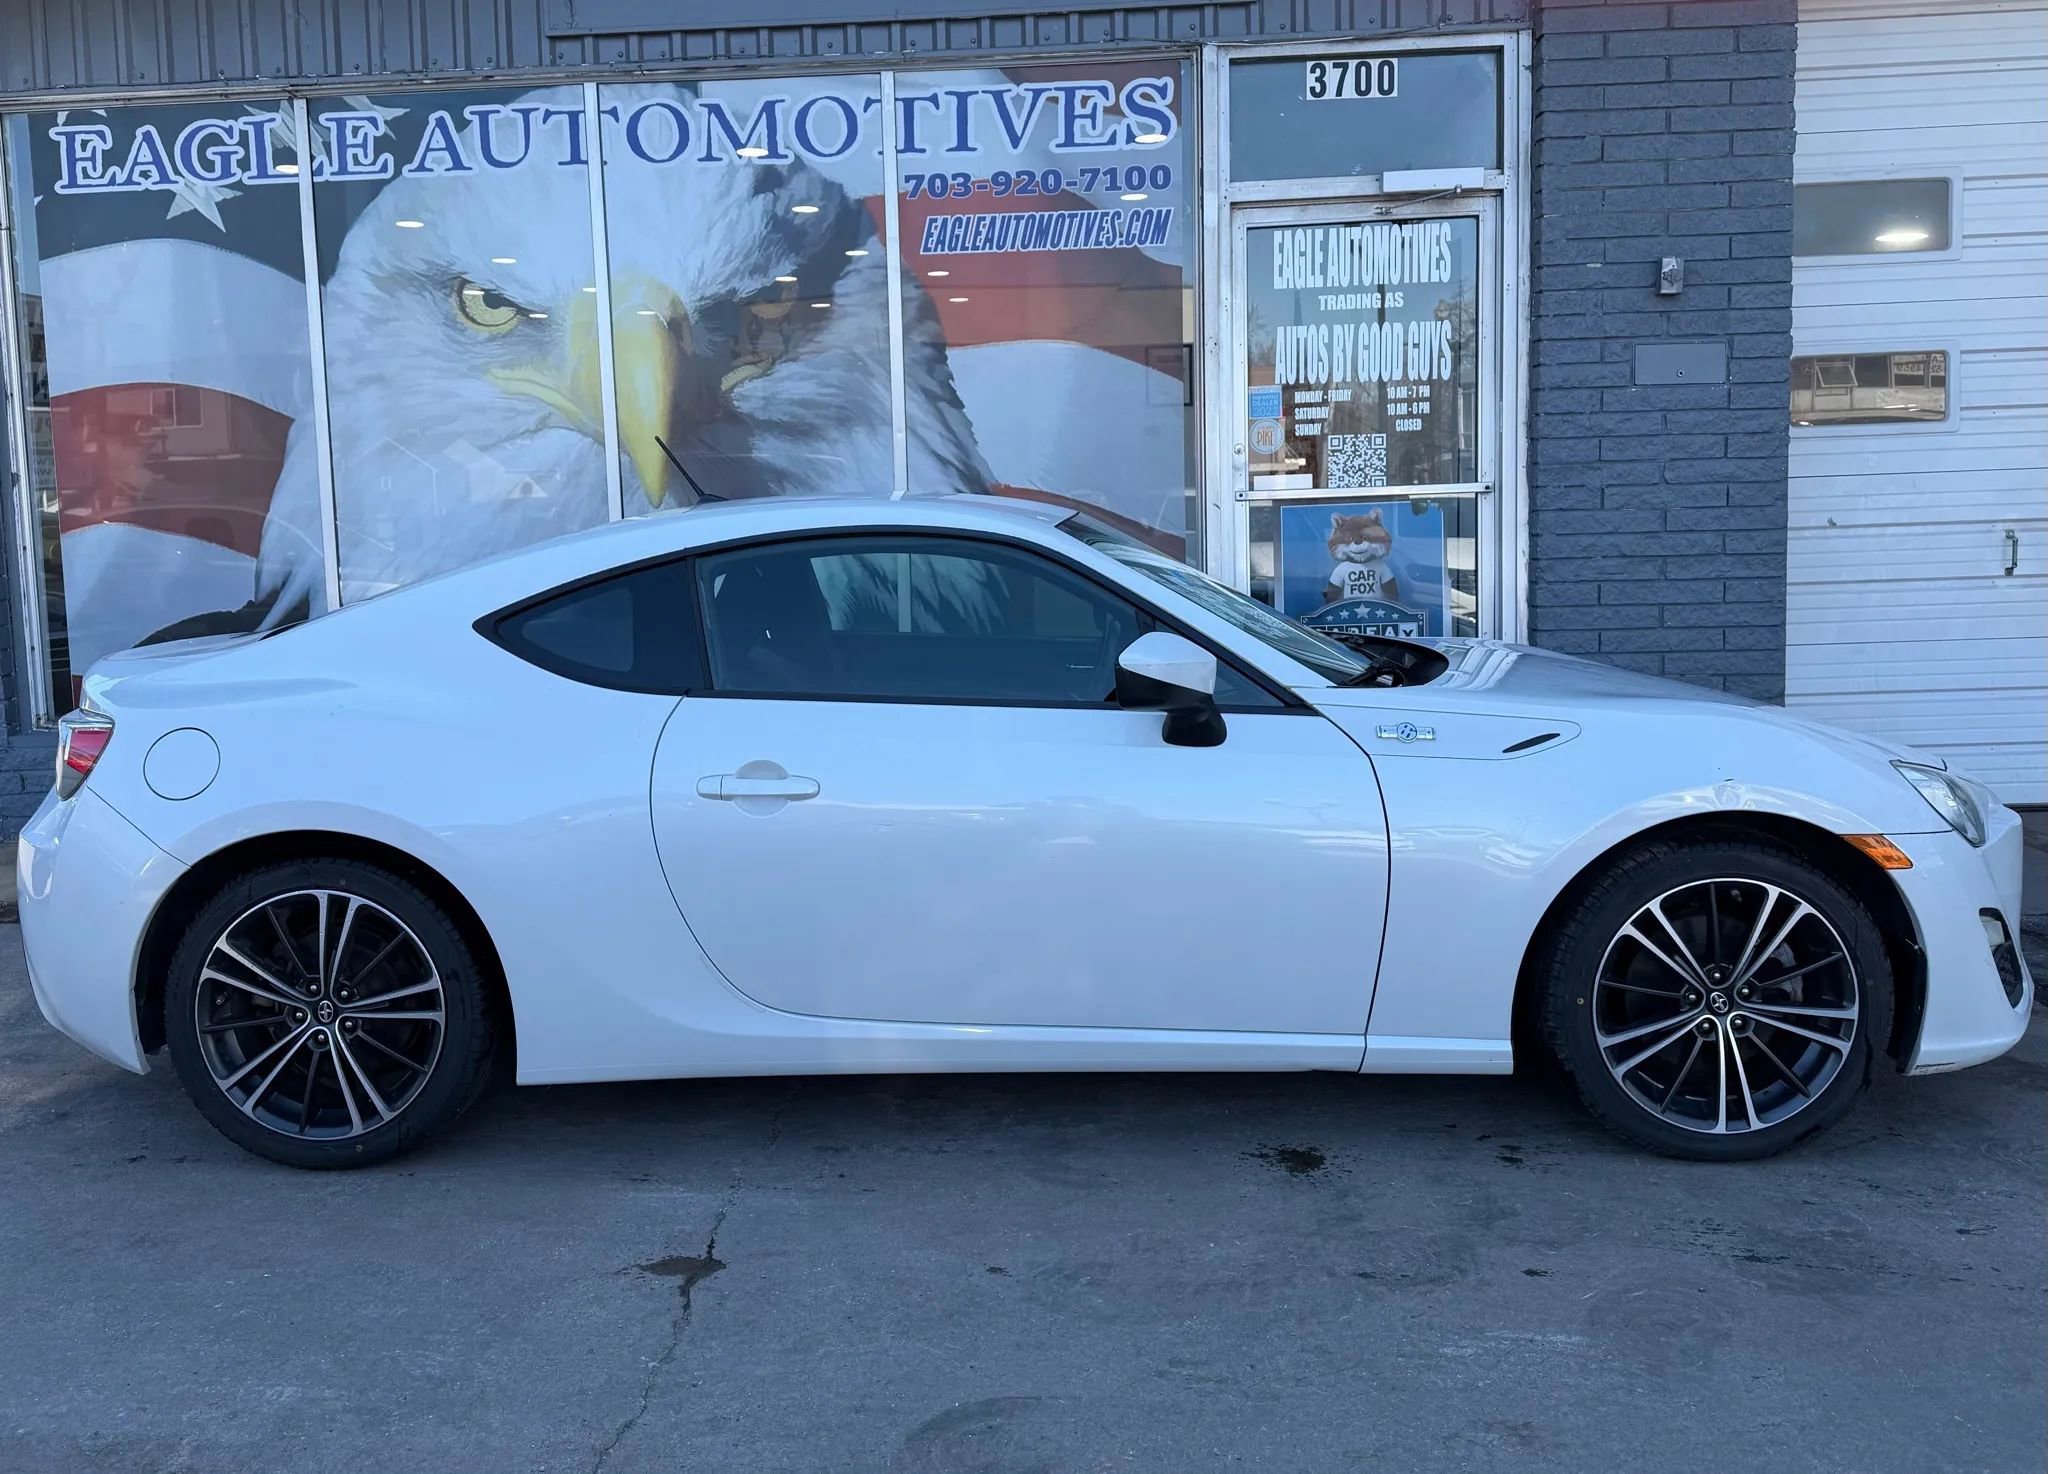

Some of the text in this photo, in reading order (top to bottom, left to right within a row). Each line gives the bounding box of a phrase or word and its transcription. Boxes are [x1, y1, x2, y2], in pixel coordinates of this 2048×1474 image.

[1309, 59, 1395, 98] 3700
[54, 78, 1175, 192] EAGLE AUTOMOTIVES
[904, 165, 1173, 200] 703-920-7100
[920, 208, 1175, 255] EAGLEAUTOMOTIVES.COM
[1273, 222, 1452, 290] EAGLE AUTOMOTIVES
[1318, 291, 1404, 311] TRADING AS
[1275, 319, 1452, 385] AUTOS BY GOOD GUYS
[1294, 390, 1323, 404] MONDAY
[1328, 389, 1352, 402] FRIDAY
[1387, 386, 1395, 399] 10
[1396, 386, 1408, 399] AM
[1412, 385, 1417, 398] 7
[1419, 385, 1430, 398] PM
[1294, 406, 1329, 420] SATURDAY
[1387, 403, 1395, 416] 10
[1396, 402, 1408, 415] AM
[1419, 401, 1430, 414] PM
[1294, 423, 1322, 436] SUNDAY
[1395, 418, 1422, 432] CLOSED
[1348, 569, 1376, 582] CAR
[1350, 582, 1376, 595] FOX
[1314, 626, 1414, 638] RFAX
